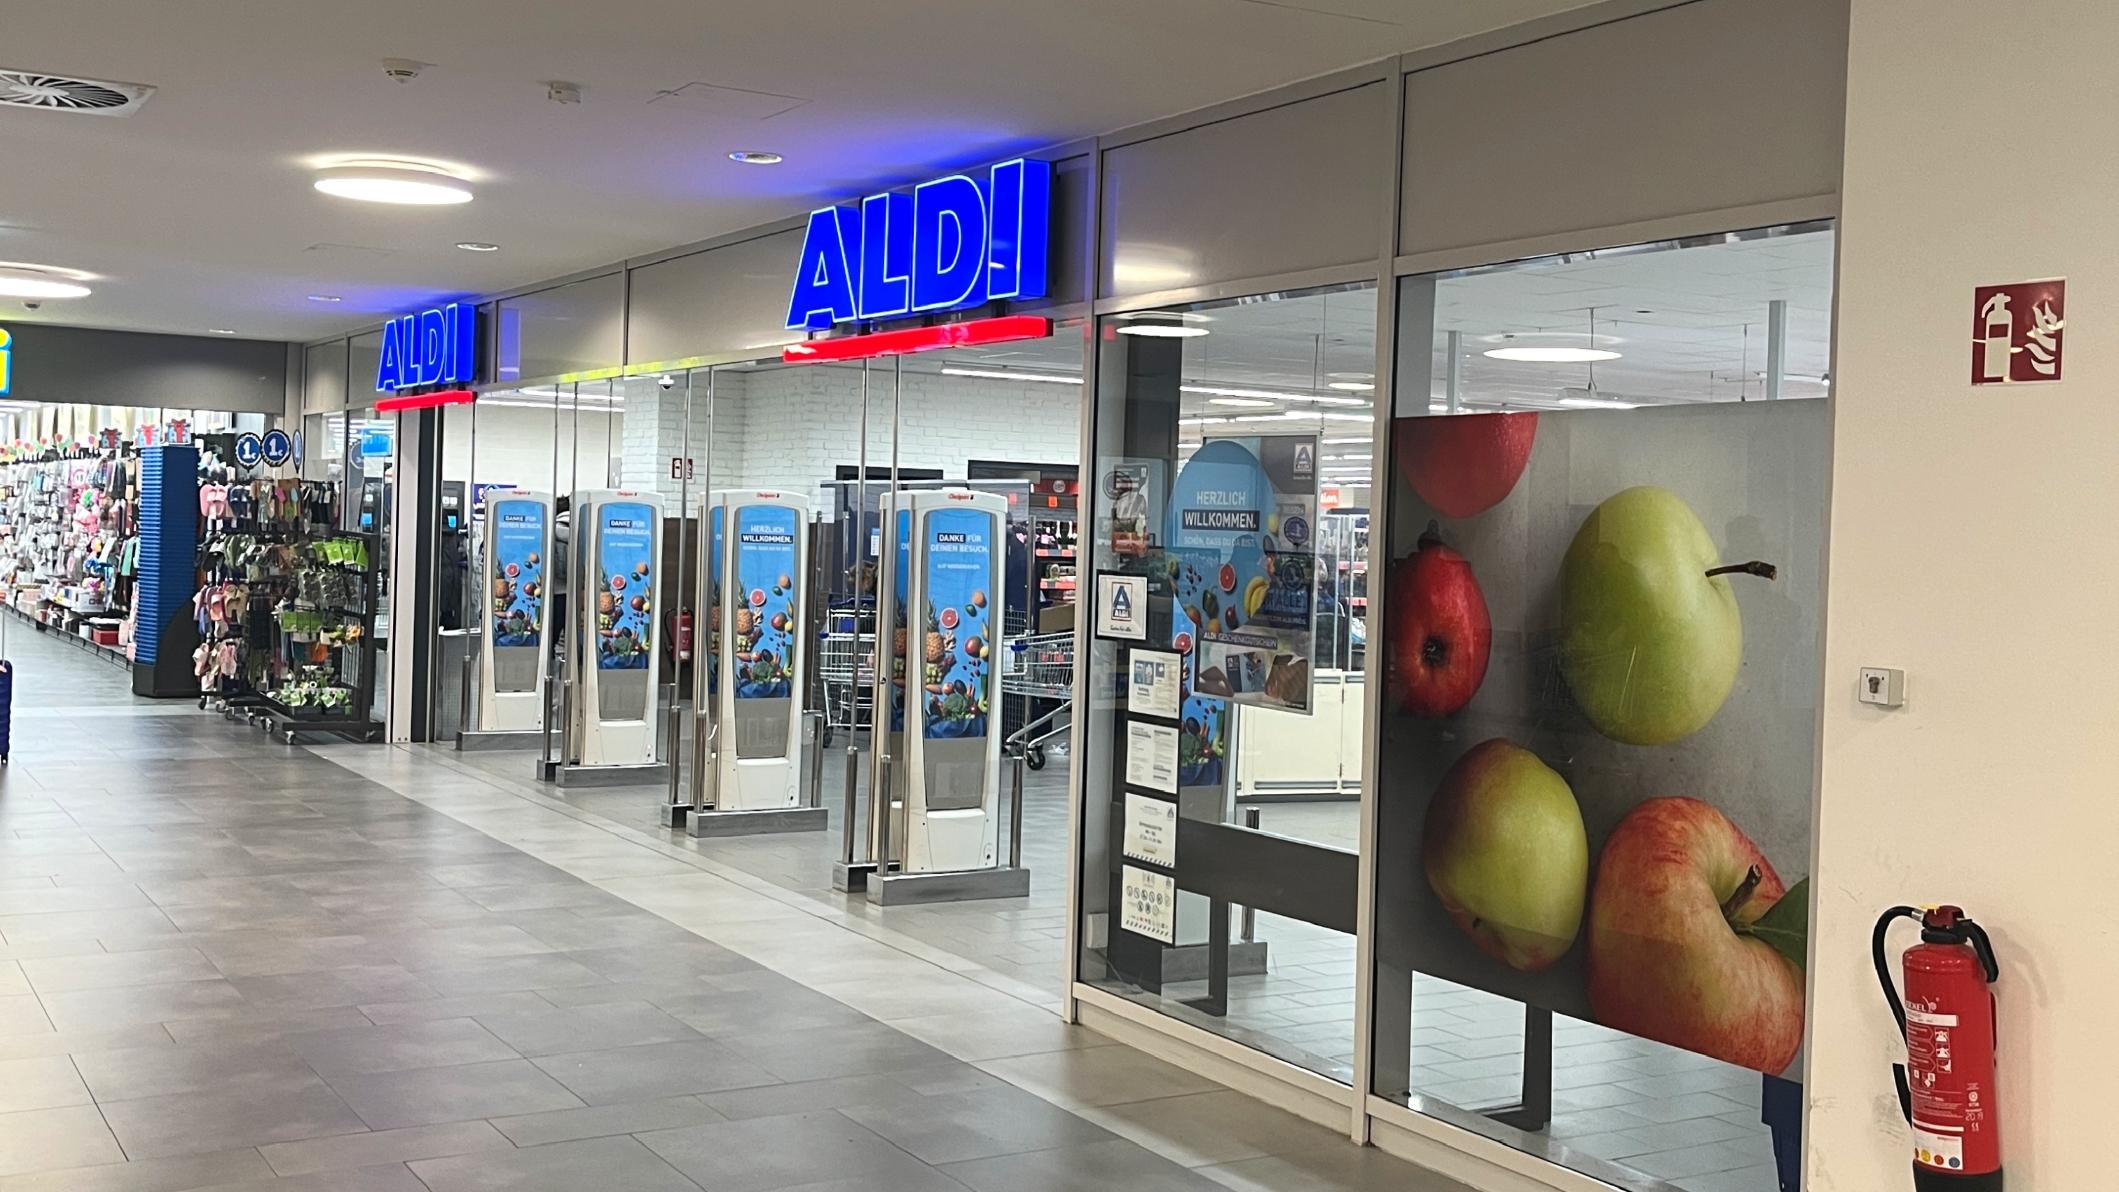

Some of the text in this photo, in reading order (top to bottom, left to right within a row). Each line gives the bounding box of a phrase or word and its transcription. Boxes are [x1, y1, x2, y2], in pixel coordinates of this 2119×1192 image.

[785, 158, 1049, 330] ALDI
[376, 303, 477, 392] ALDI
[1196, 490, 1246, 506] HERZLICH
[1184, 511, 1256, 529] WILLKOMMEN.
[742, 534, 793, 543] WILLKOMMEN.
[938, 534, 964, 543] DANKE
